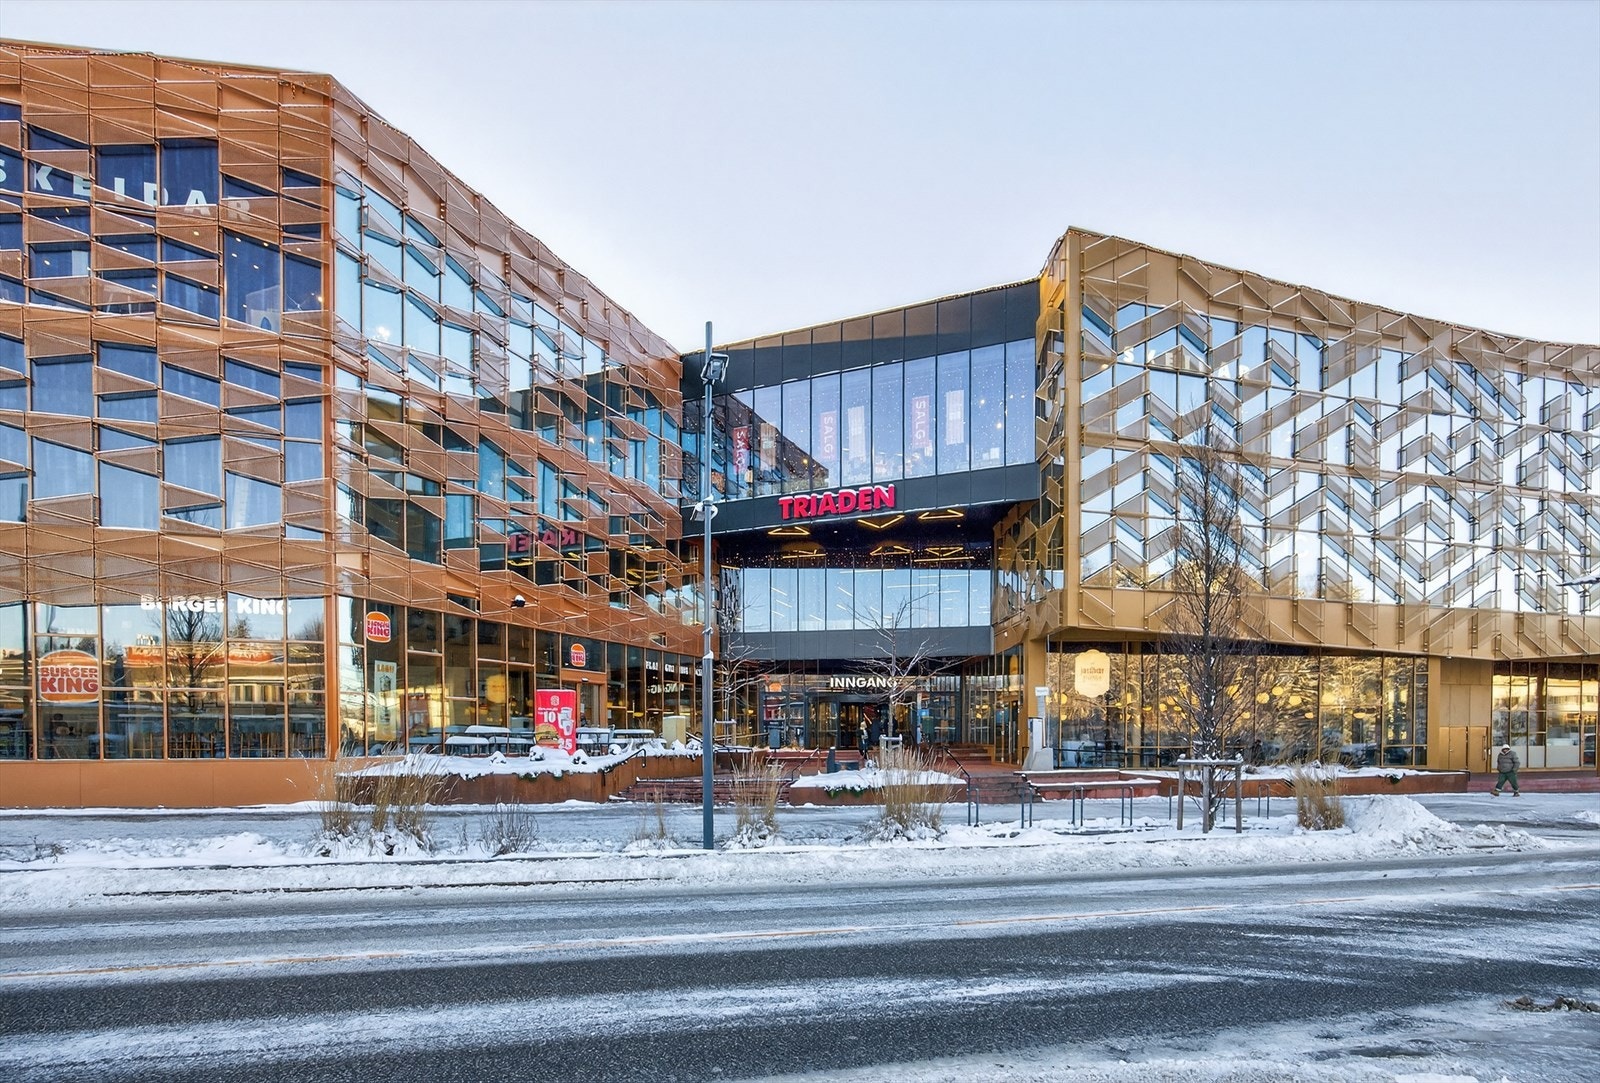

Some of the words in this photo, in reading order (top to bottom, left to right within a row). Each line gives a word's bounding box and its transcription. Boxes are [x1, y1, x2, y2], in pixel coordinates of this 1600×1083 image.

[915, 400, 926, 440] SALG
[823, 416, 834, 454] SALG
[778, 484, 896, 520] TRIADEN
[237, 597, 292, 615] KING
[40, 666, 98, 678] BURGER
[40, 677, 99, 693] KING
[543, 711, 557, 724] 10
